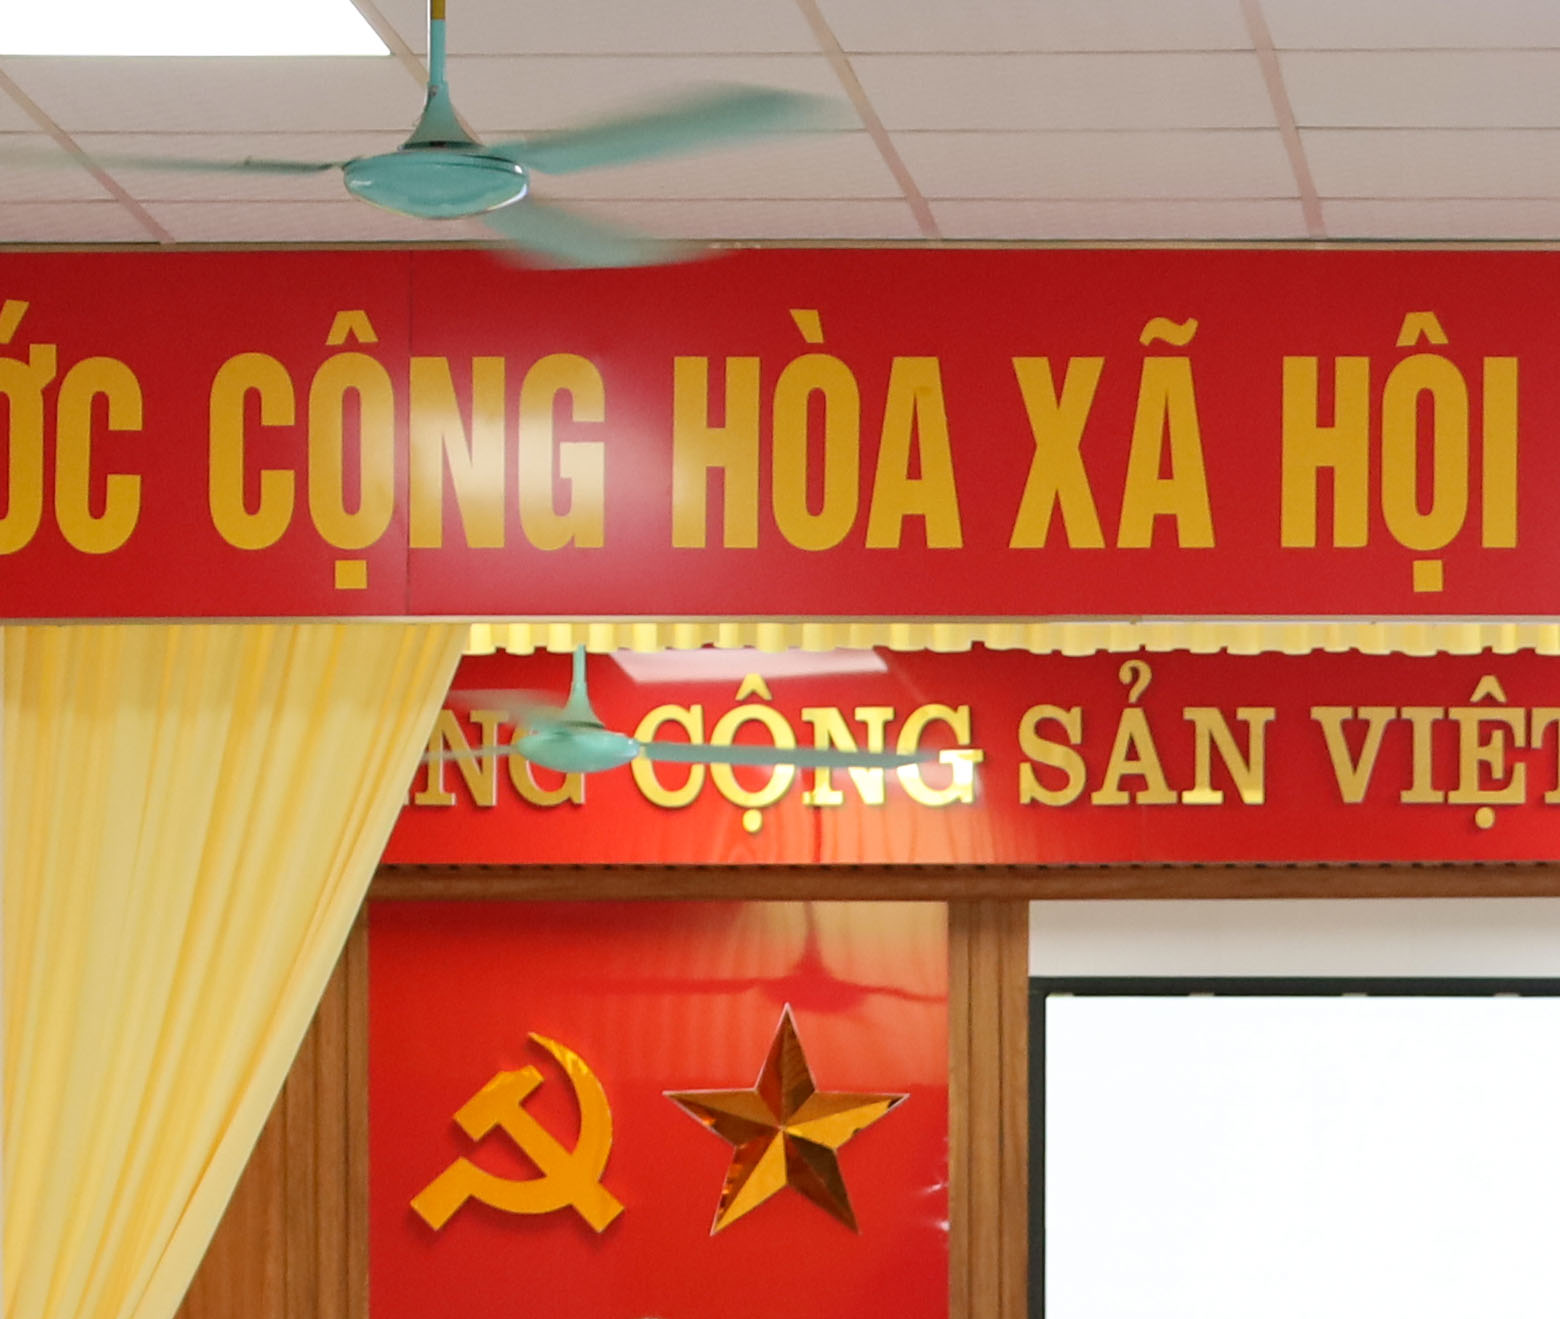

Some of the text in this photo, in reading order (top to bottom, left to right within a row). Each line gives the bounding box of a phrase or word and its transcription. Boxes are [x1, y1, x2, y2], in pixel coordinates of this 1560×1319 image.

[210, 311, 603, 589] CỘNG
[674, 311, 963, 550] HÒA
[1010, 318, 1215, 548] XÃ
[1282, 312, 1518, 592] HỘI
[630, 673, 983, 833] CỘNG
[1018, 659, 1275, 807] SẢN
